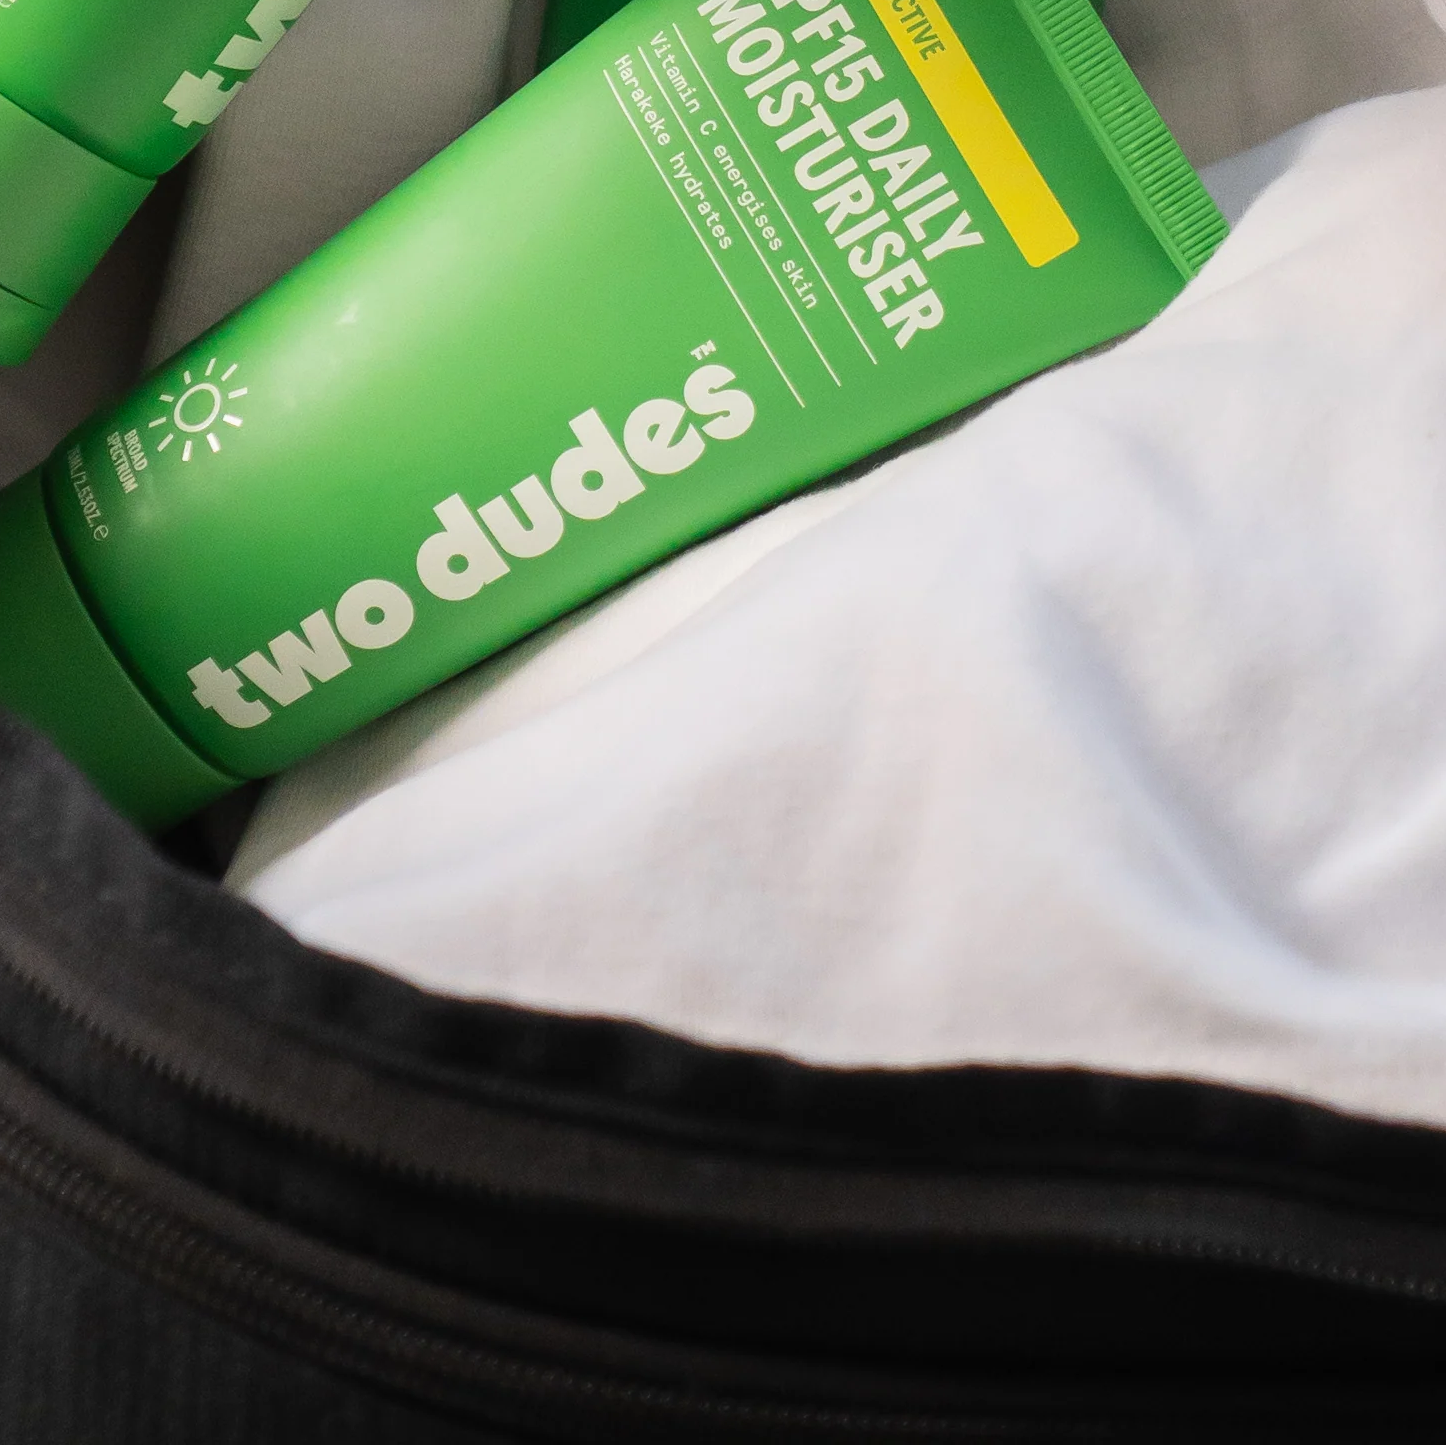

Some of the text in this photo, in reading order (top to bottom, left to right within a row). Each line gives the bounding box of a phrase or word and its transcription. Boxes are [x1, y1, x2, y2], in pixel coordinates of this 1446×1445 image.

[614, 54, 733, 250] Harakeke hydrates
[649, 30, 818, 310] Vitamin C energises skin
[847, 98, 985, 262] DAILY
[106, 431, 138, 494] SPECTRUM
[124, 428, 148, 471] BROAD
[186, 364, 756, 730] two dudes
